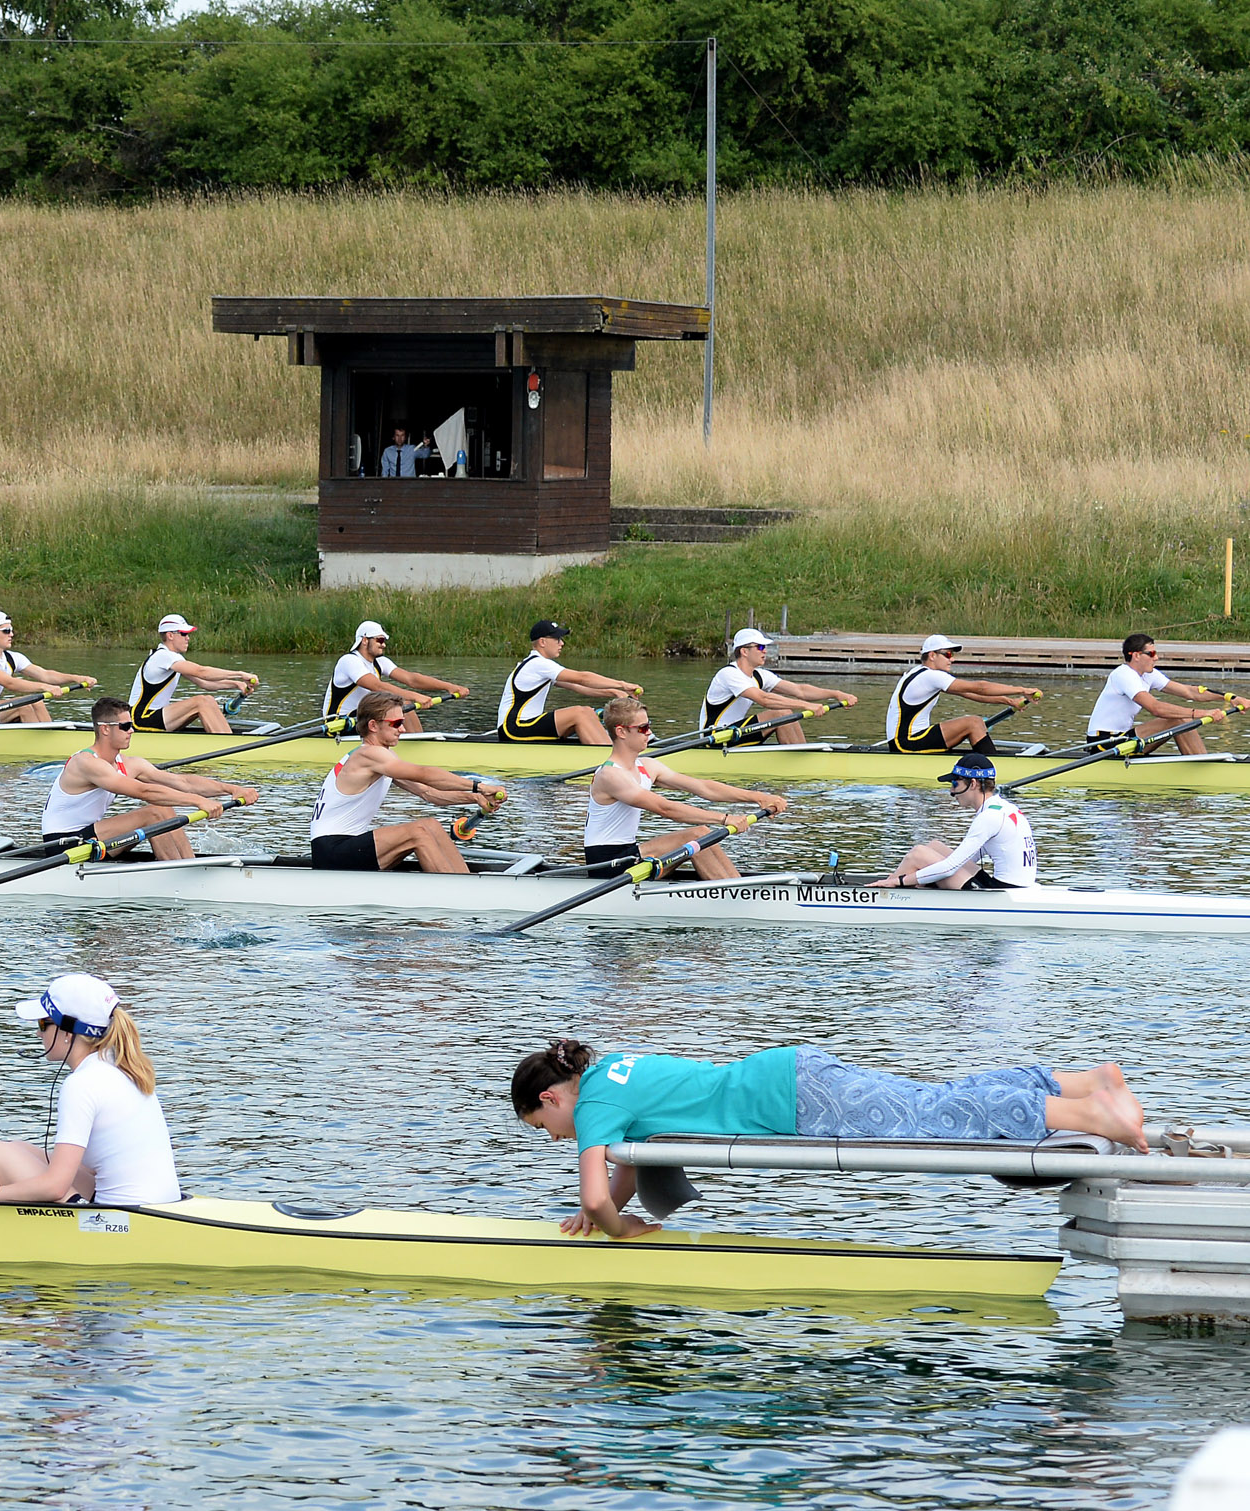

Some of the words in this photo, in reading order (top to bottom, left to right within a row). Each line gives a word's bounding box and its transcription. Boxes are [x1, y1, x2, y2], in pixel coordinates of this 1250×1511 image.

[797, 886, 879, 904] Münster
[41, 996, 56, 1017] NK
[84, 1025, 104, 1037] NK
[15, 1207, 75, 1218] EMPACHER
[105, 1224, 129, 1233] RZ86
